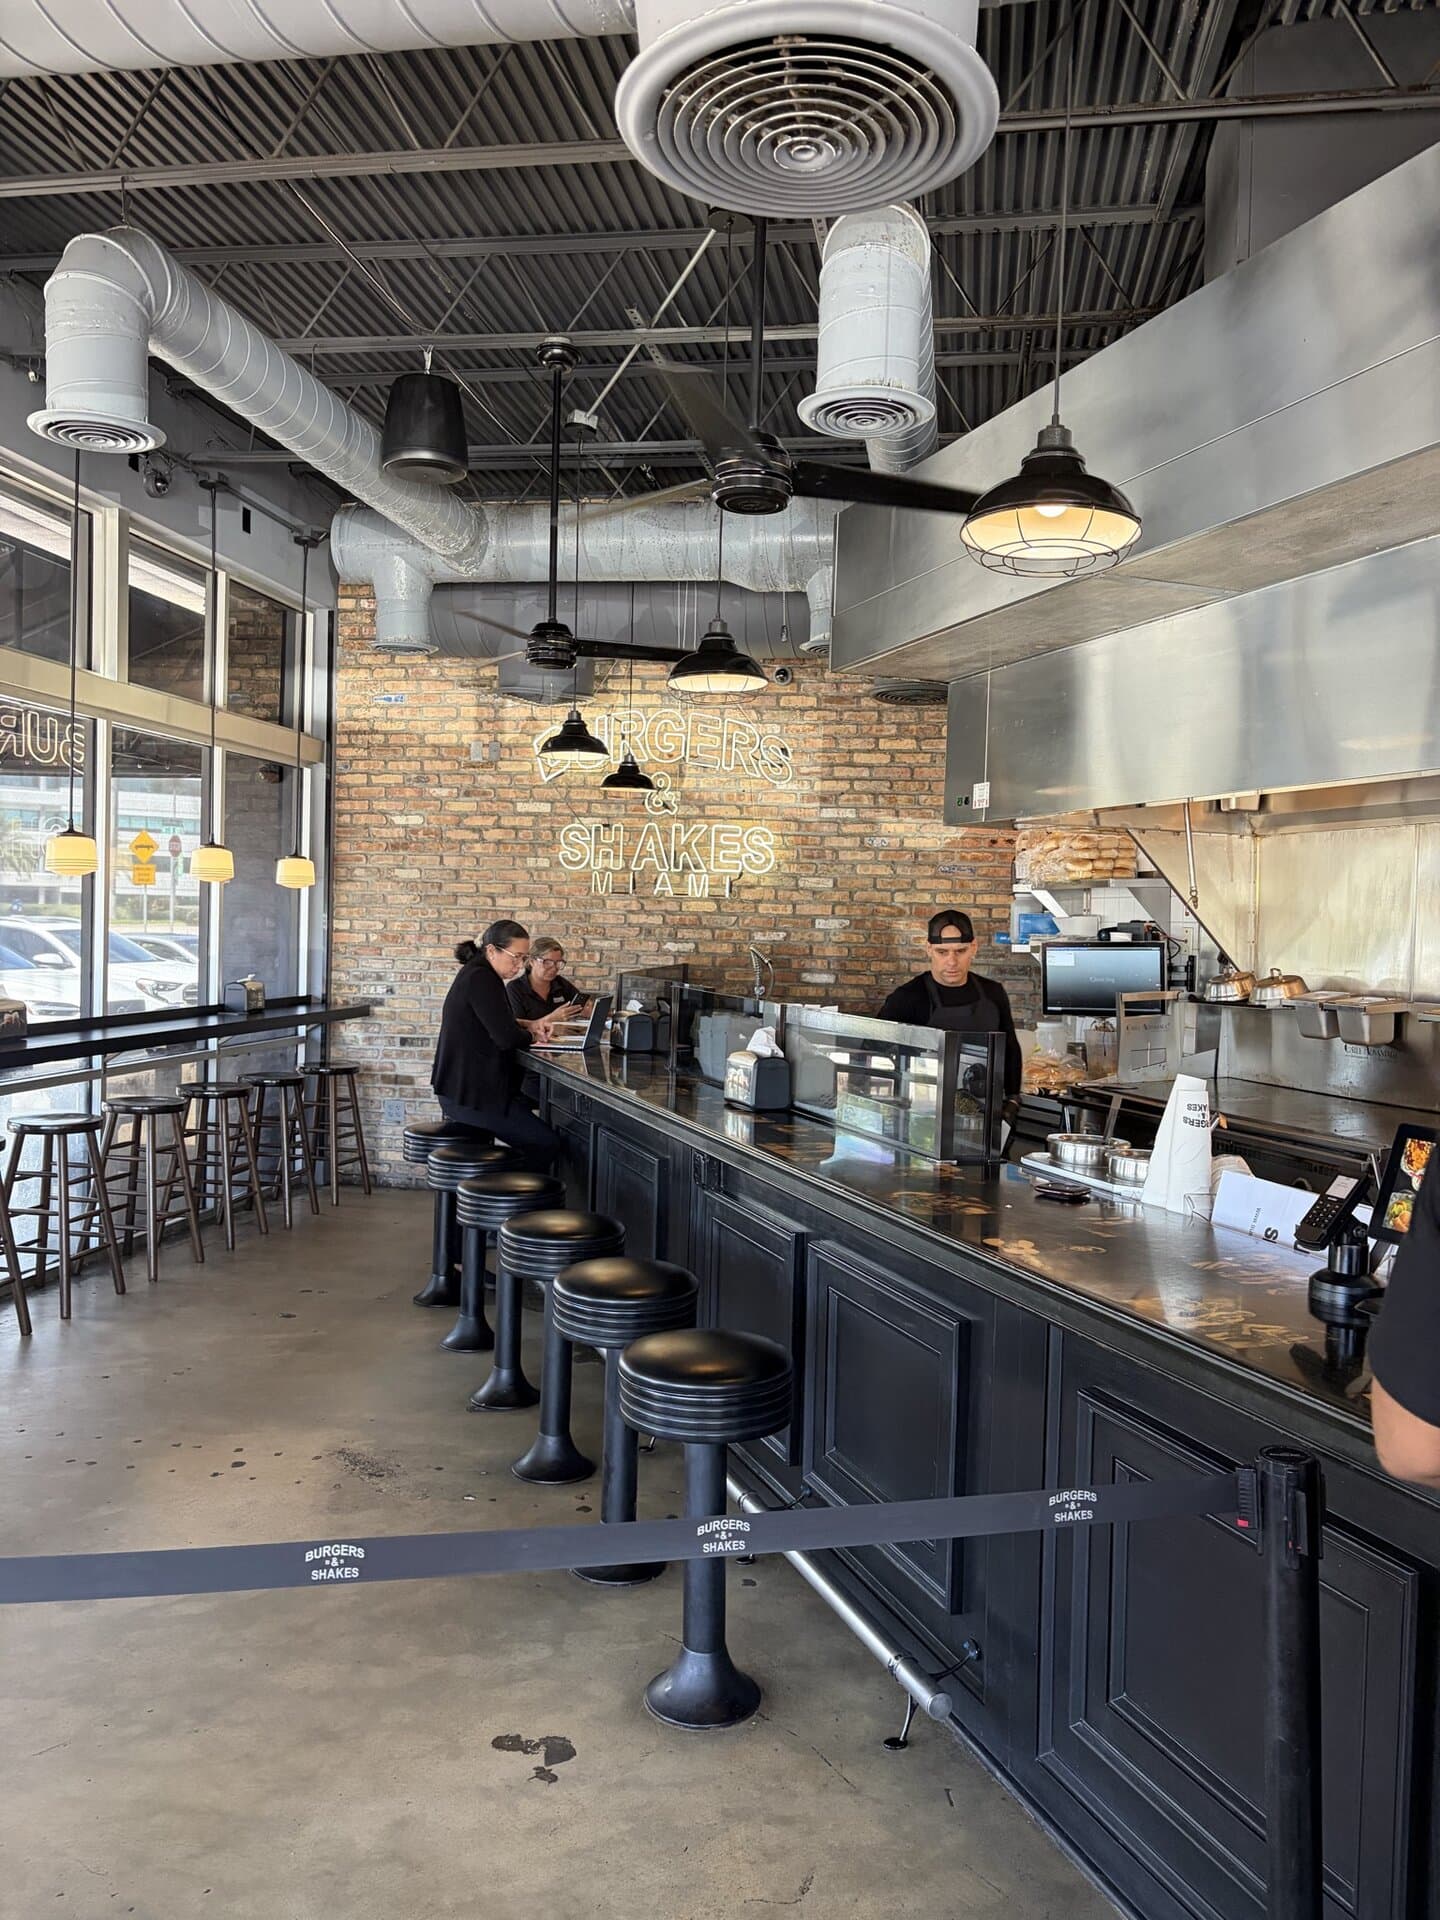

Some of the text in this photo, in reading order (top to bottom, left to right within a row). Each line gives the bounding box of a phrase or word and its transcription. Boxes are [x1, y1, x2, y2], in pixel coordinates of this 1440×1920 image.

[643, 770, 681, 816] &
[558, 822, 776, 875] SHAKES
[590, 870, 737, 899] MIAMI
[1048, 1489, 1098, 1507] BURGERS
[1069, 1501, 1077, 1510] &
[1054, 1510, 1094, 1523] SHAKES
[696, 1519, 751, 1537] BURGERS
[719, 1530, 728, 1540] &
[304, 1543, 366, 1563] BURGERS
[702, 1540, 746, 1553] SHAKES
[330, 1556, 340, 1568] &
[310, 1567, 360, 1581] SHAKES
